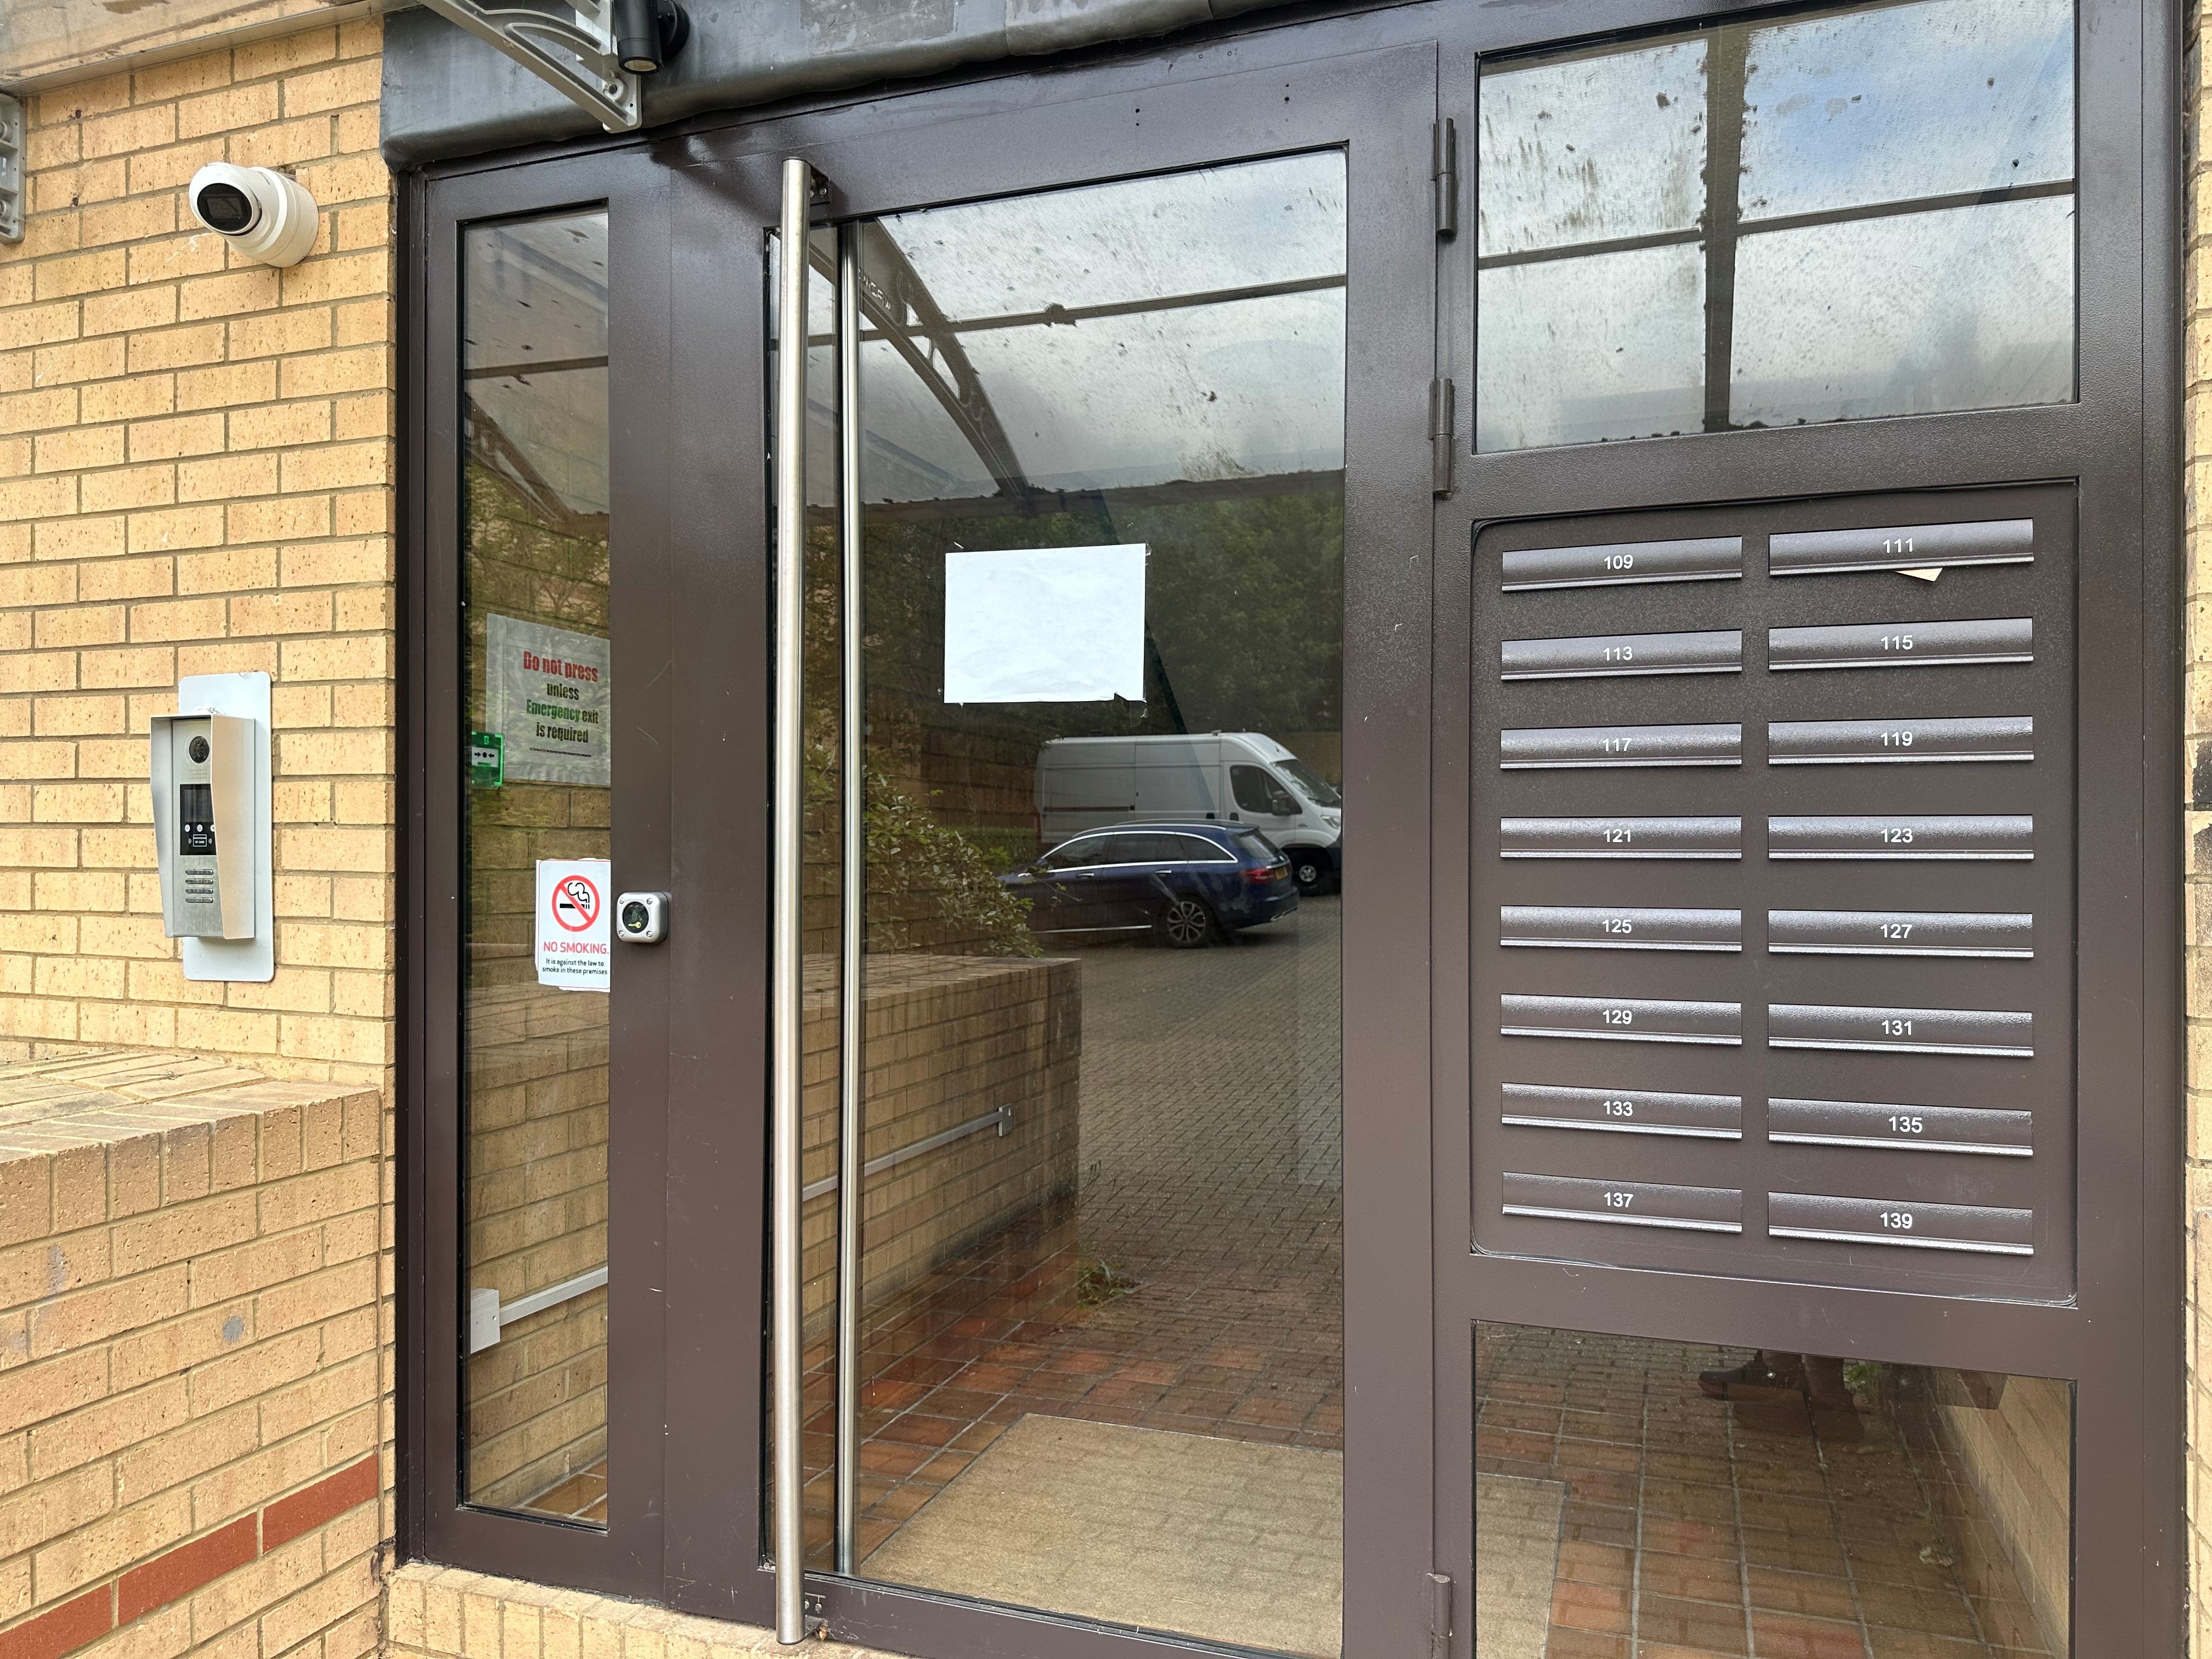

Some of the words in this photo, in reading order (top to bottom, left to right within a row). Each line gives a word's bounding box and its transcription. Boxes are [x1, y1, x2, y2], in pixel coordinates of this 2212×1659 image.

[1882, 538, 1913, 554] 111
[1604, 554, 1633, 569] 109
[1880, 635, 1913, 650] 115
[1602, 646, 1633, 661] 113
[523, 651, 539, 671] Do
[543, 658, 562, 675] not
[565, 662, 598, 682] press
[547, 683, 579, 700] unless
[527, 699, 580, 722] Emergency
[582, 710, 599, 724] exit
[536, 722, 545, 737] is
[547, 726, 589, 743] required
[1880, 731, 1913, 747] 119
[1602, 737, 1632, 752] 117
[1602, 828, 1632, 843] 121
[1880, 827, 1913, 843] 123
[1602, 918, 1632, 934] 125
[1880, 923, 1912, 939] 127
[544, 941, 557, 952] NO
[1602, 1009, 1632, 1025] 129
[1881, 1020, 1912, 1036] 131
[1603, 1101, 1633, 1116] 133
[1888, 1116, 1923, 1133] 135
[1604, 1192, 1634, 1208] 137
[1880, 1212, 1912, 1229] 139
